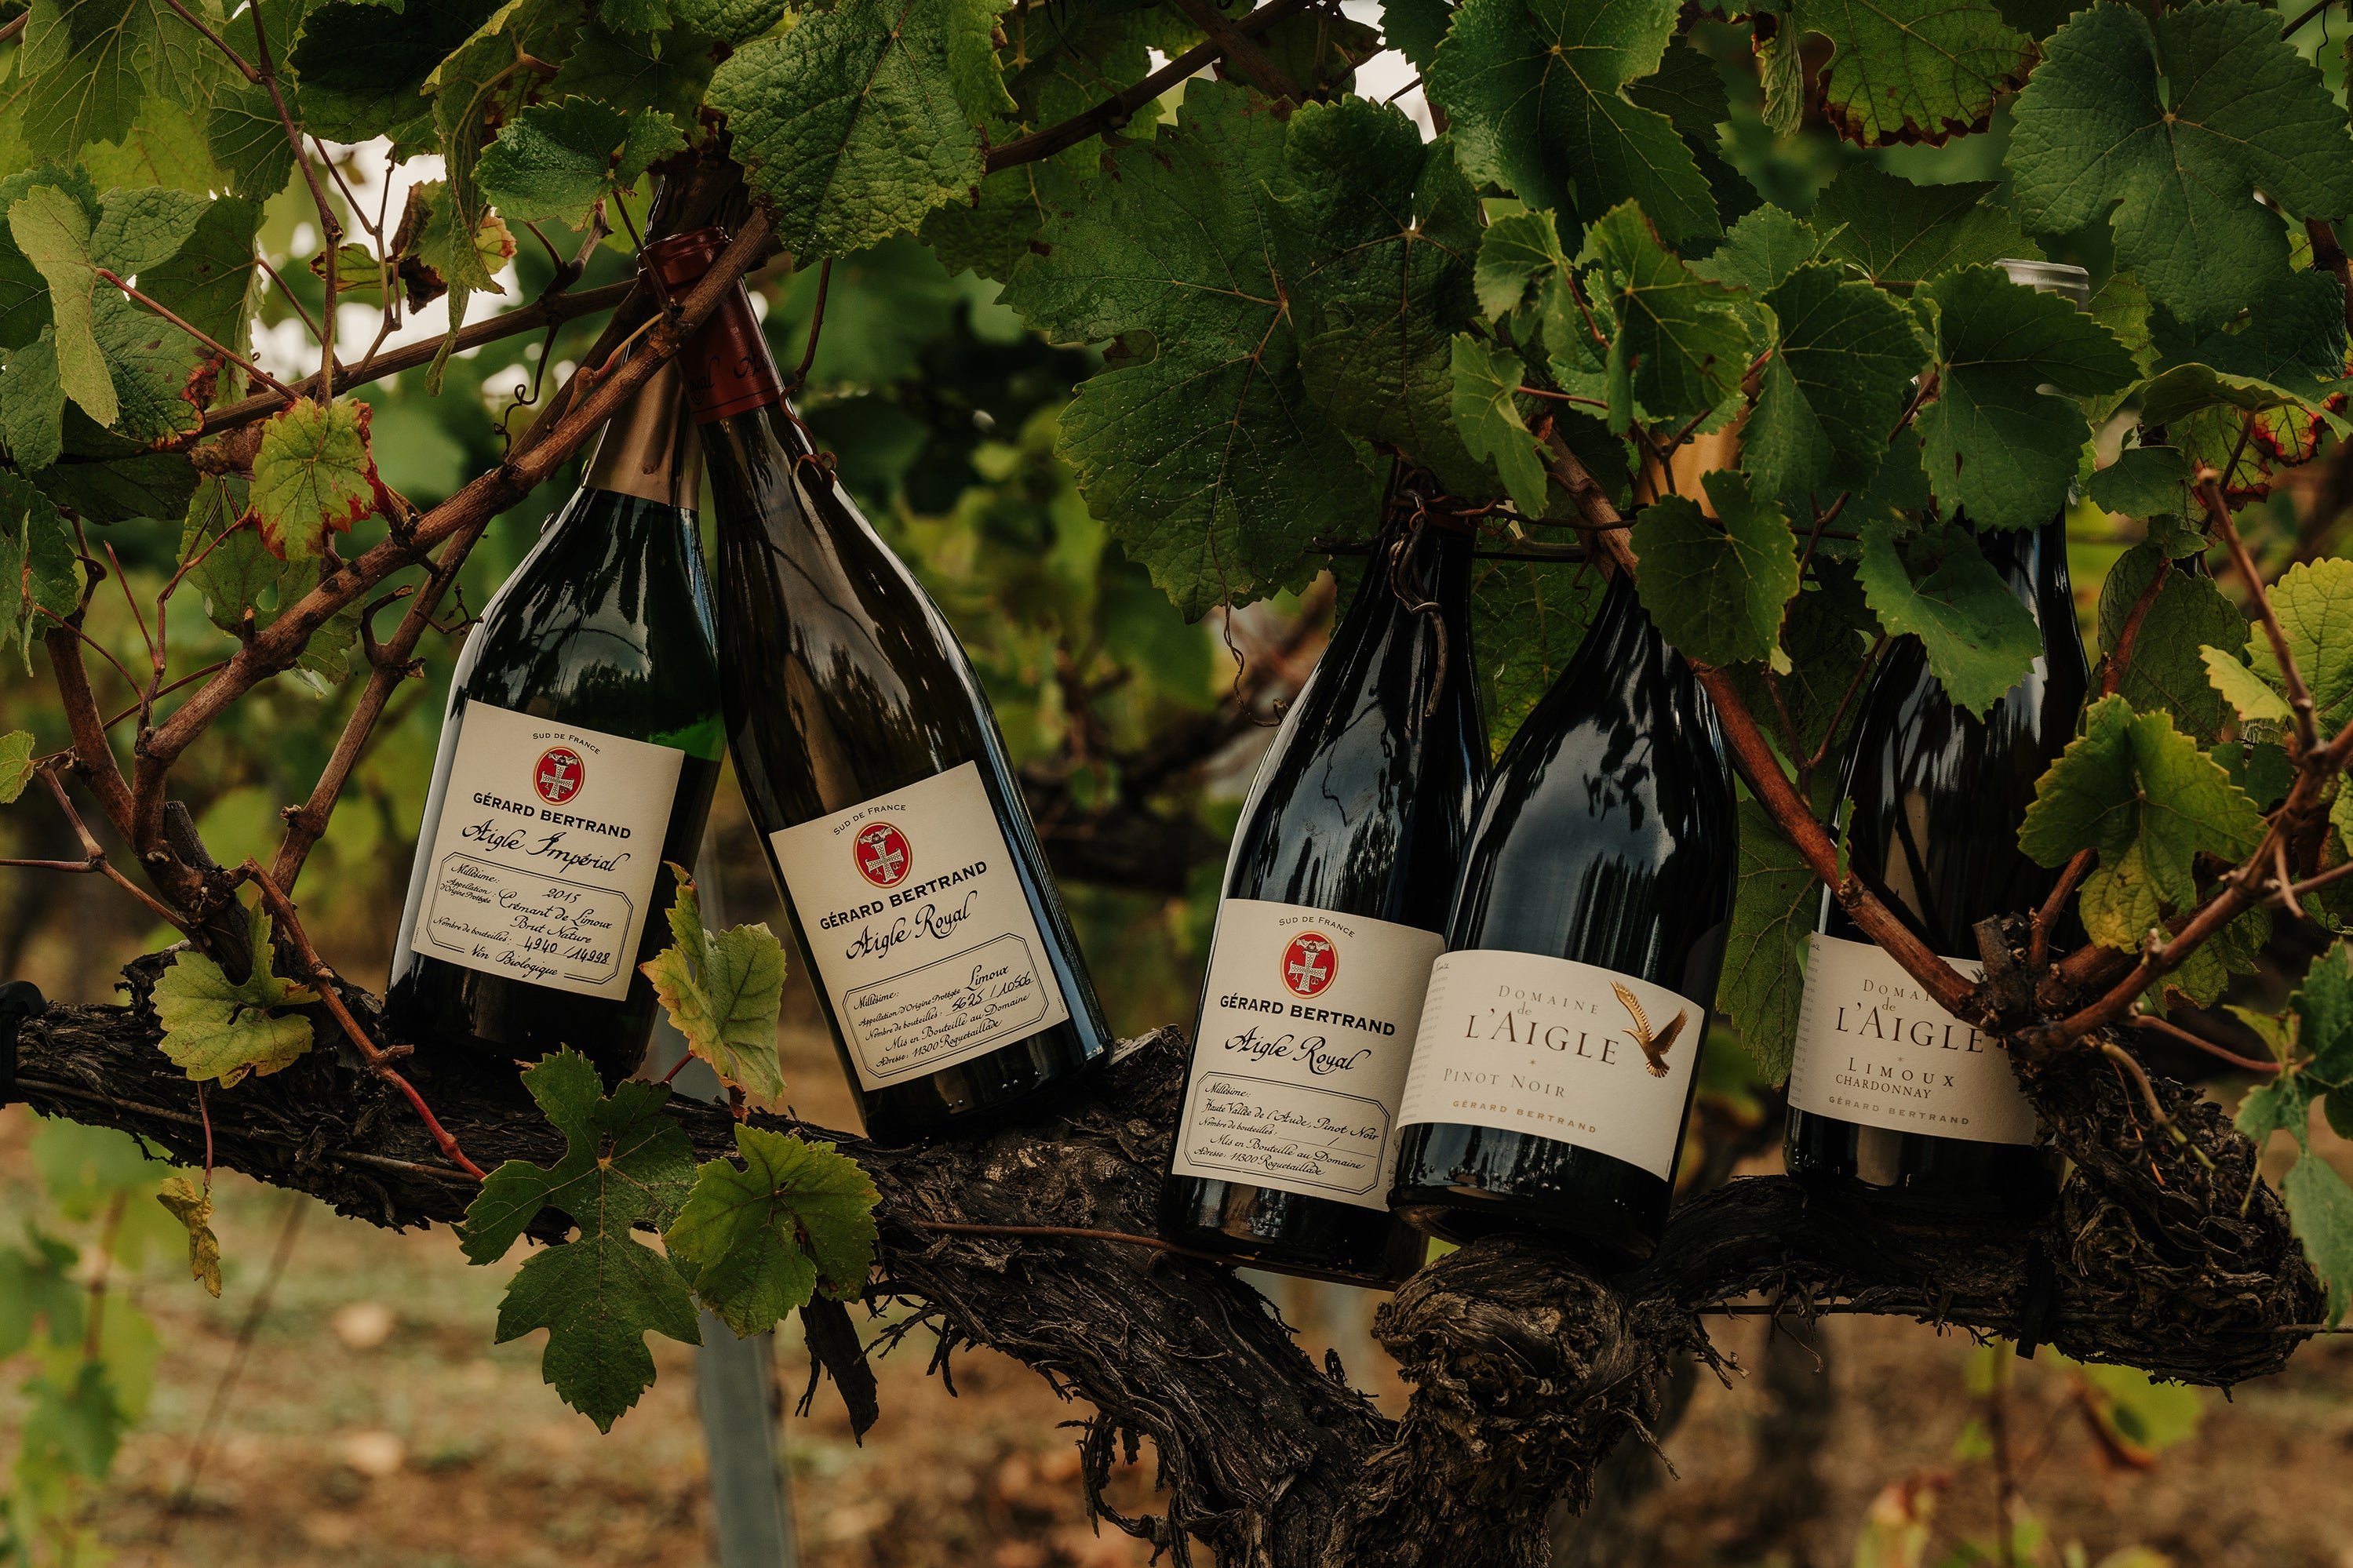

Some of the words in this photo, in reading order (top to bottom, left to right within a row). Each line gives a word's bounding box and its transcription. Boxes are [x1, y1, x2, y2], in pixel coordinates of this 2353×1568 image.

[683, 355, 720, 406] oyal
[569, 734, 600, 755] FRANCE
[473, 792, 535, 817] GÉRARD
[540, 809, 631, 839] BERTRAND
[833, 820, 851, 835] SUD
[852, 812, 865, 821] DE
[868, 804, 906, 815] FRANCE
[462, 819, 526, 852] Aigle
[526, 832, 631, 874] Impérial
[498, 889, 554, 918] Crémant
[555, 907, 569, 921] de
[570, 908, 613, 929] Limoux
[542, 888, 581, 904] 2015
[820, 900, 883, 930] GÉRARD
[888, 861, 987, 908] BERTRAND
[433, 916, 461, 930] Nombre
[462, 923, 470, 933] de
[523, 936, 558, 954] 4940
[510, 915, 546, 933] Brut
[547, 926, 592, 943] Nature
[846, 917, 912, 959] Aigle
[915, 890, 978, 940] Royal
[1279, 917, 1299, 926] SUD
[1318, 917, 1355, 938] FRANCE
[472, 944, 489, 959] Vin
[495, 950, 558, 977] Biologique
[858, 1011, 900, 1028] Appellation
[964, 965, 1008, 991] Limoux
[1499, 985, 1598, 1014] DOMAINE
[1863, 979, 1929, 1001] DOMAI
[1881, 997, 1896, 1011] de
[885, 1035, 907, 1051] Mis
[921, 1013, 967, 1040] Bouteille
[984, 993, 1030, 1017] Domaine
[1220, 992, 1284, 1014] GÉRARD
[1290, 1005, 1397, 1036] BERTRAND
[1517, 1001, 1532, 1016] de
[865, 1028, 893, 1041] Nombre
[892, 1023, 901, 1031] de
[912, 1042, 939, 1057] 11300
[940, 1018, 1006, 1048] Roquetaillade
[1466, 1008, 1619, 1065] L'AIGLE
[1835, 1002, 1984, 1053] L'AIGLE
[1225, 1026, 1295, 1061] Aigle
[1292, 1036, 1372, 1075] Royal
[1444, 1068, 1499, 1085] PINOT
[1511, 1075, 1564, 1097] NOIR
[1836, 1074, 1932, 1099] CHARDONNAY
[1849, 1057, 1954, 1087] LIMOUX
[1199, 1117, 1227, 1128] Nombre
[1227, 1120, 1236, 1129] de
[1201, 1098, 1226, 1112] Haute
[1227, 1102, 1251, 1116] Vallée
[1254, 1107, 1264, 1119] de
[1313, 1118, 1348, 1133] Pinot
[1350, 1126, 1379, 1141] Noir
[1453, 1100, 1507, 1112] GÉRARD
[1517, 1108, 1596, 1133] BERTRAND
[1829, 1096, 1879, 1111] GÉRARD
[1889, 1108, 1969, 1125] BERTRAND
[1210, 1134, 1233, 1146] Mis
[1246, 1138, 1298, 1155] Bouteille
[1313, 1151, 1366, 1169] Domaine
[1230, 1152, 1258, 1163] 11300
[1258, 1155, 1326, 1175] Roquetaillade
